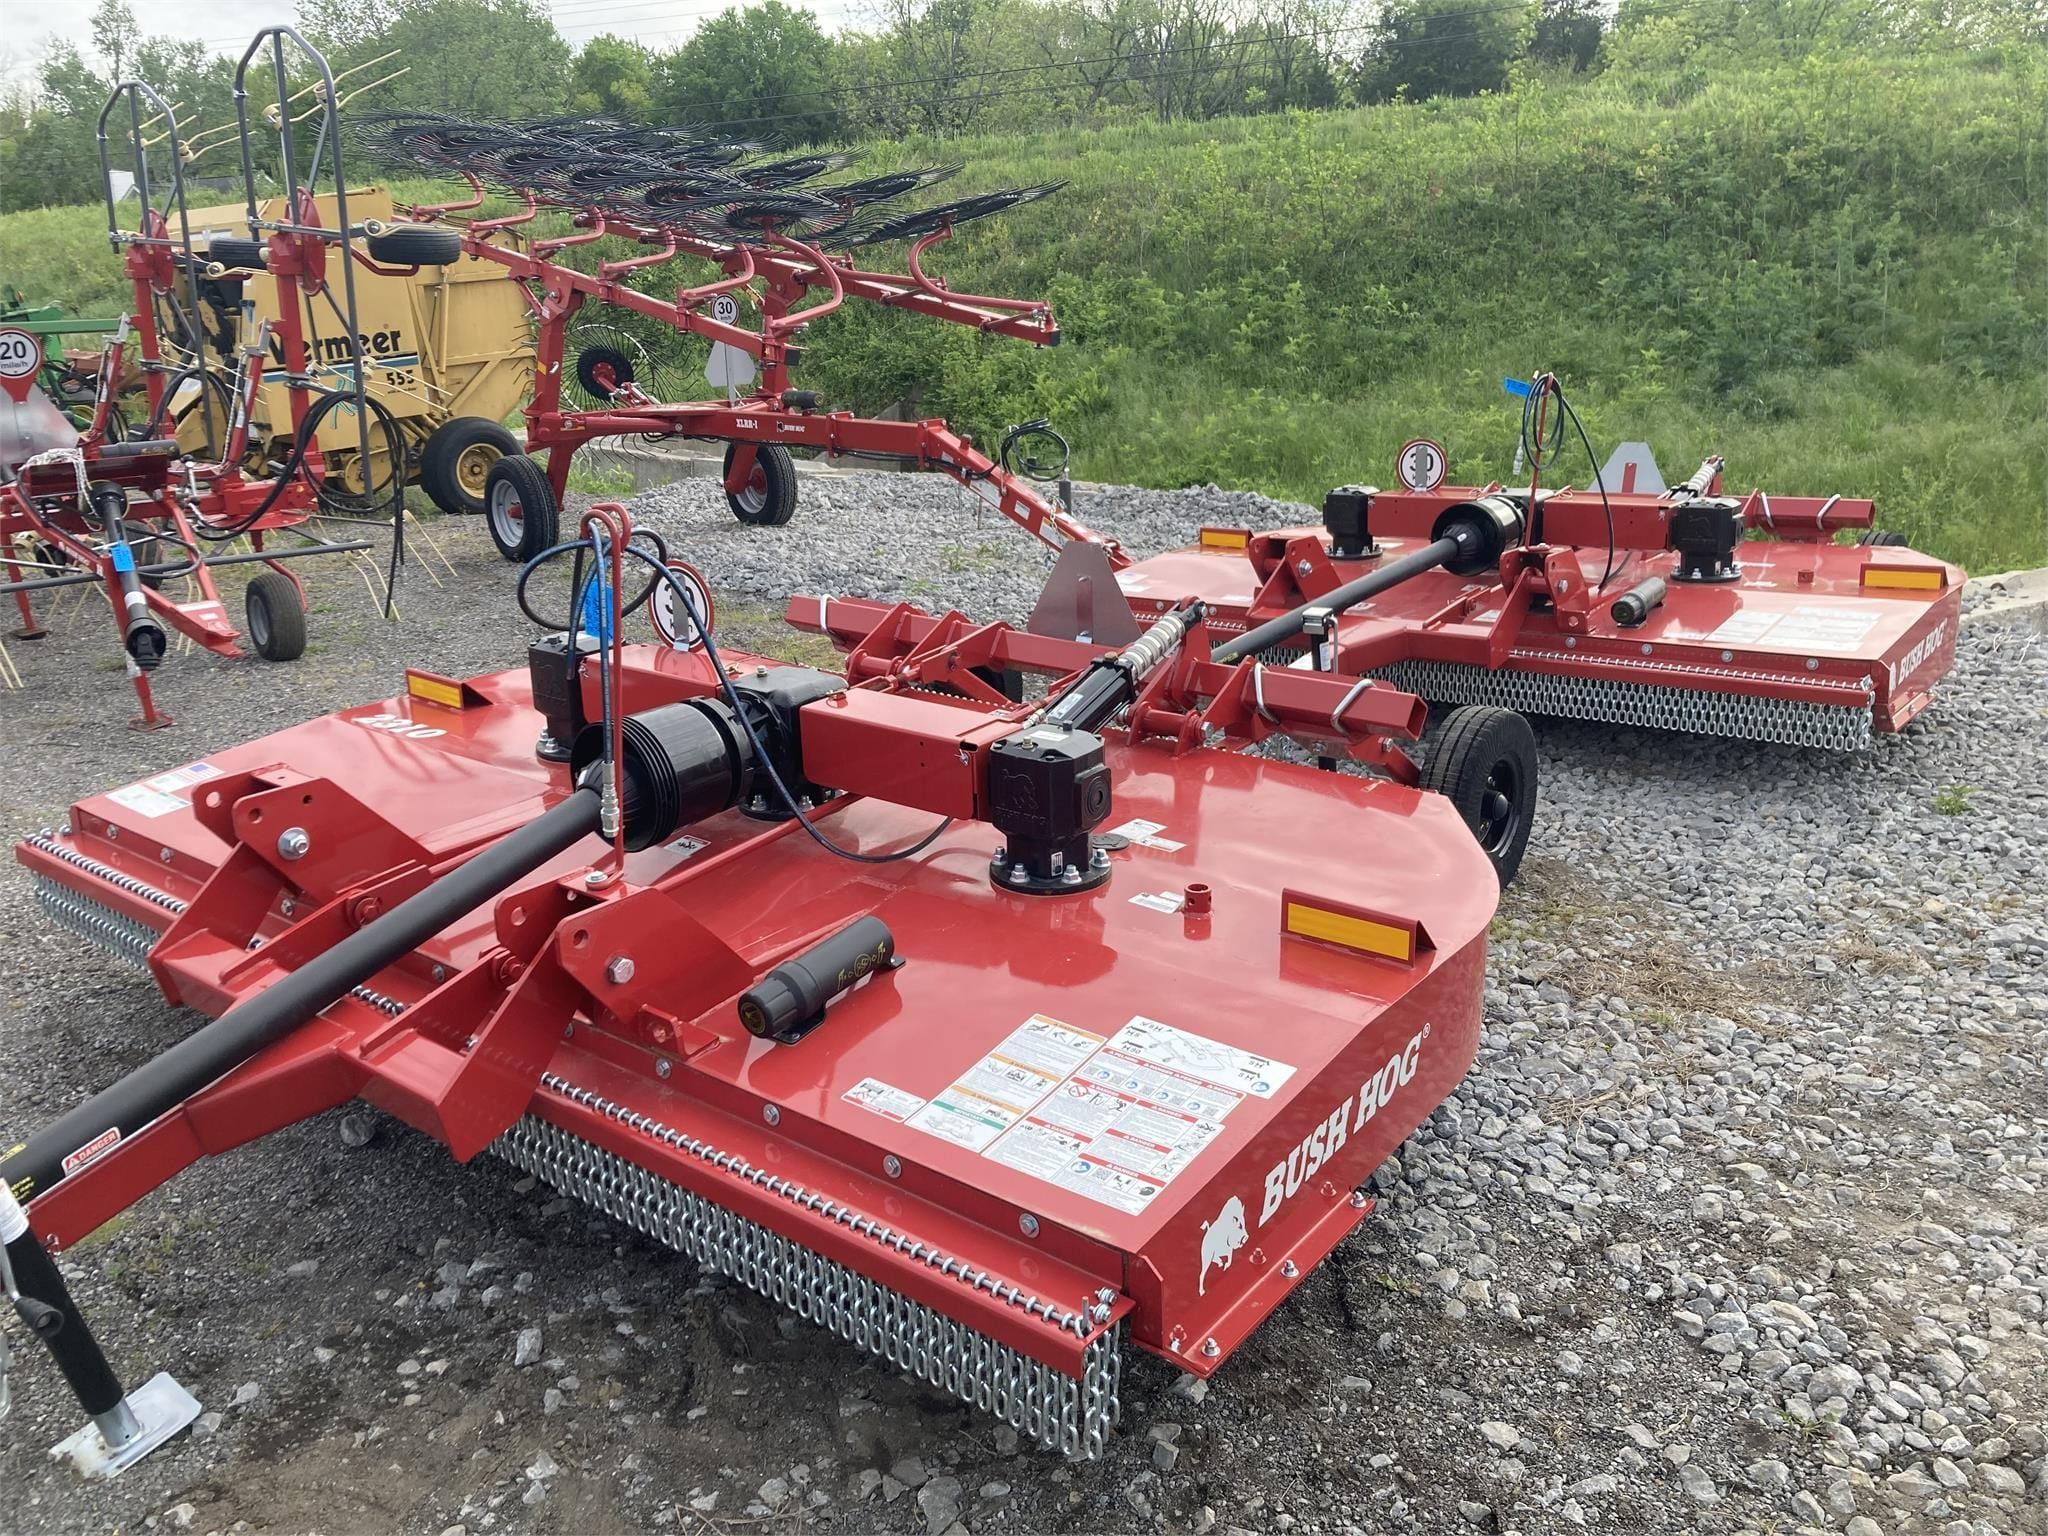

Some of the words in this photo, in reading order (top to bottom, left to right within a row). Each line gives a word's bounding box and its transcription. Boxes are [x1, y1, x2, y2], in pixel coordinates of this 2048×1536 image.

[718, 301, 733, 314] 30
[0, 340, 26, 360] 20
[386, 369, 415, 386] 555
[1898, 638, 1926, 686] BUSH
[1923, 617, 1948, 661] HOG
[351, 713, 448, 739] 2310
[1258, 1096, 1354, 1228] BUSH
[1353, 1031, 1423, 1135] HOG
[78, 1131, 117, 1160] DANGER
